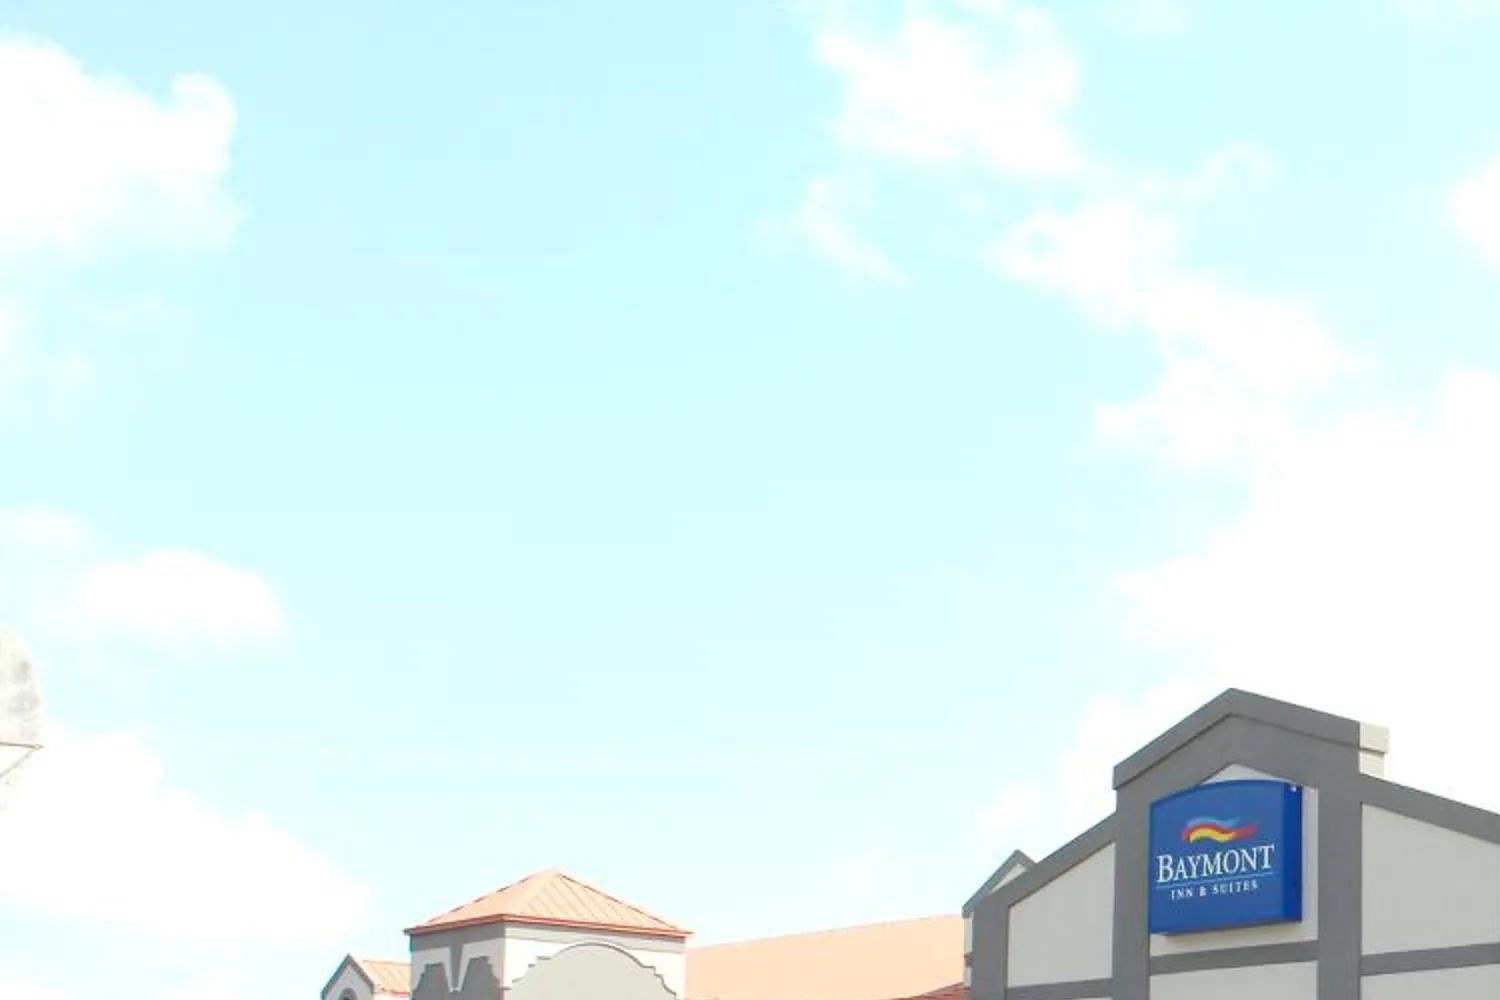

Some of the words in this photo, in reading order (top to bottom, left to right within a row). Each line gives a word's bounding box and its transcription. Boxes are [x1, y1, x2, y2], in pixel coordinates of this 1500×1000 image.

[1156, 844, 1276, 883] BAYMONT
[1171, 888, 1193, 901] INN
[1199, 885, 1207, 897] &
[1212, 879, 1259, 895] SUITES
